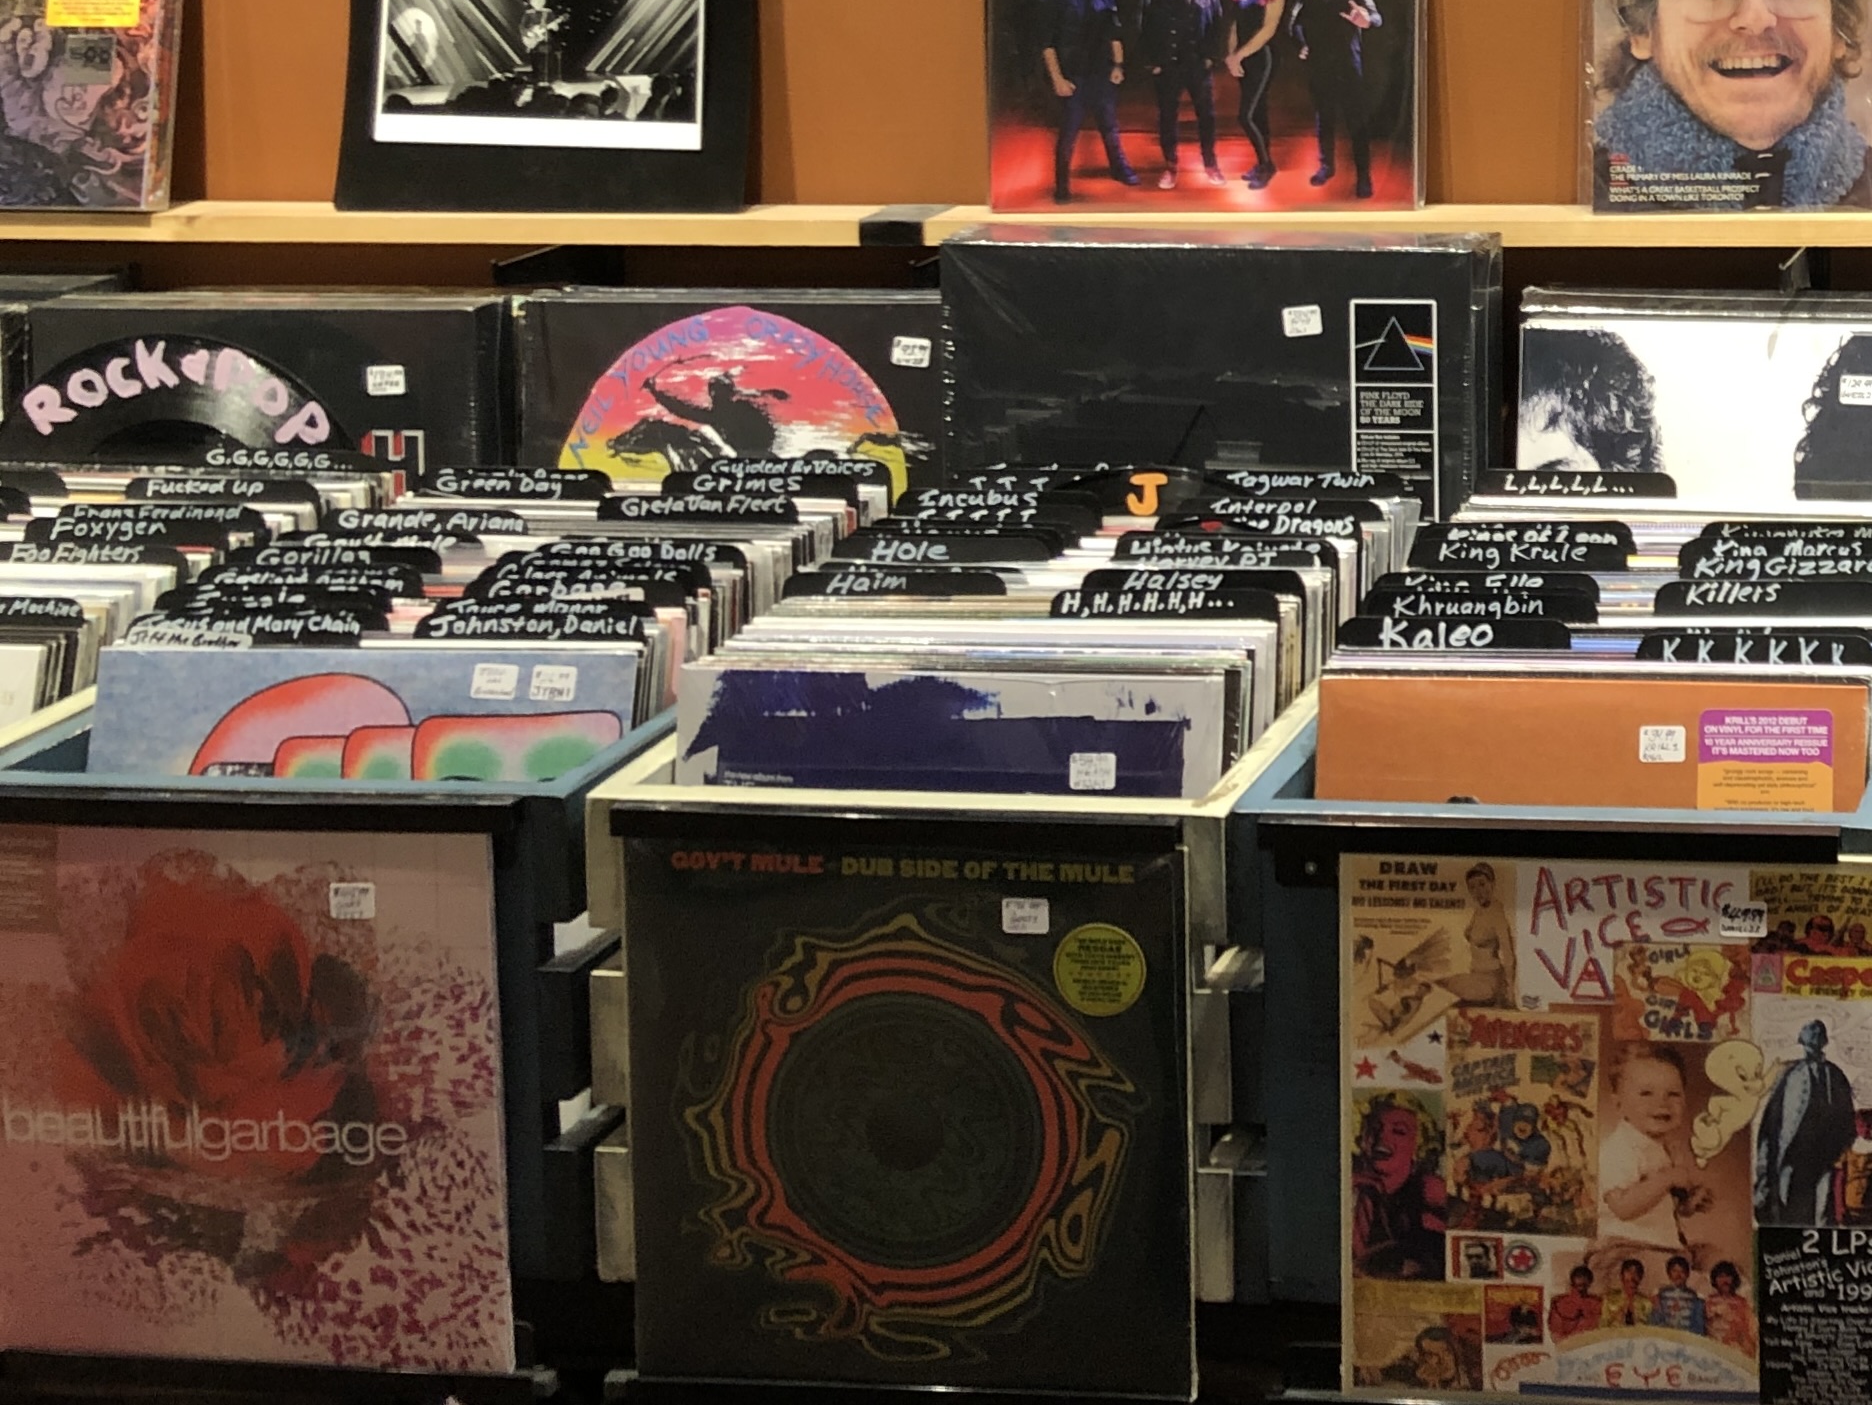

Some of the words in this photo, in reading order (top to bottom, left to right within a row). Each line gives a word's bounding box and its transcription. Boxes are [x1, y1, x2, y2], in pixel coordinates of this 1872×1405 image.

[23, 339, 179, 435] ROCK
[213, 347, 331, 445] POP
[568, 393, 614, 470] NEIL
[609, 316, 710, 394] YOUNG
[744, 315, 827, 370] CRAZY
[436, 475, 511, 493] Green
[519, 477, 563, 500] Day
[693, 474, 804, 494] Grimes
[1125, 471, 1169, 516] J
[917, 489, 1039, 508] Incubus
[49, 518, 167, 542] Foxygen
[1271, 515, 1355, 535] Dragons
[9, 543, 51, 564] Foo
[53, 543, 145, 565] Fighters
[870, 539, 950, 562] Hole
[1438, 542, 1501, 569] King
[1509, 542, 1588, 562] Krule
[1693, 556, 1761, 580] King
[826, 573, 908, 596] Haim
[1123, 571, 1224, 590] Halsey
[1685, 582, 1783, 605] Killers
[1393, 593, 1544, 619] Khruangbin
[429, 615, 561, 639] Johnston,
[564, 615, 638, 636] Daniel
[1379, 616, 1495, 651] Kaleo
[1703, 725, 1718, 735] ON
[1719, 725, 1744, 735] VINYL
[1744, 725, 1764, 735] FOR
[1764, 725, 1781, 735] THE
[1782, 725, 1806, 736] FIRST
[1807, 725, 1829, 736] TIME
[670, 849, 746, 873] GOV'T
[750, 852, 825, 875] MULE
[840, 856, 894, 877] DUB
[900, 857, 957, 879] SIDE
[963, 858, 998, 881] OF
[1002, 860, 1054, 883] THE
[1058, 862, 1135, 885] MULE
[1378, 860, 1439, 876] DRAW
[1358, 879, 1385, 892] THE
[1388, 879, 1427, 893] FIRST
[1429, 880, 1458, 893] DAY
[1529, 866, 1736, 937] ARTISTIC
[2, 1095, 409, 1166] beautifulgarbage
[1802, 1229, 1820, 1254] 2
[1769, 1269, 1845, 1296] Artistic
